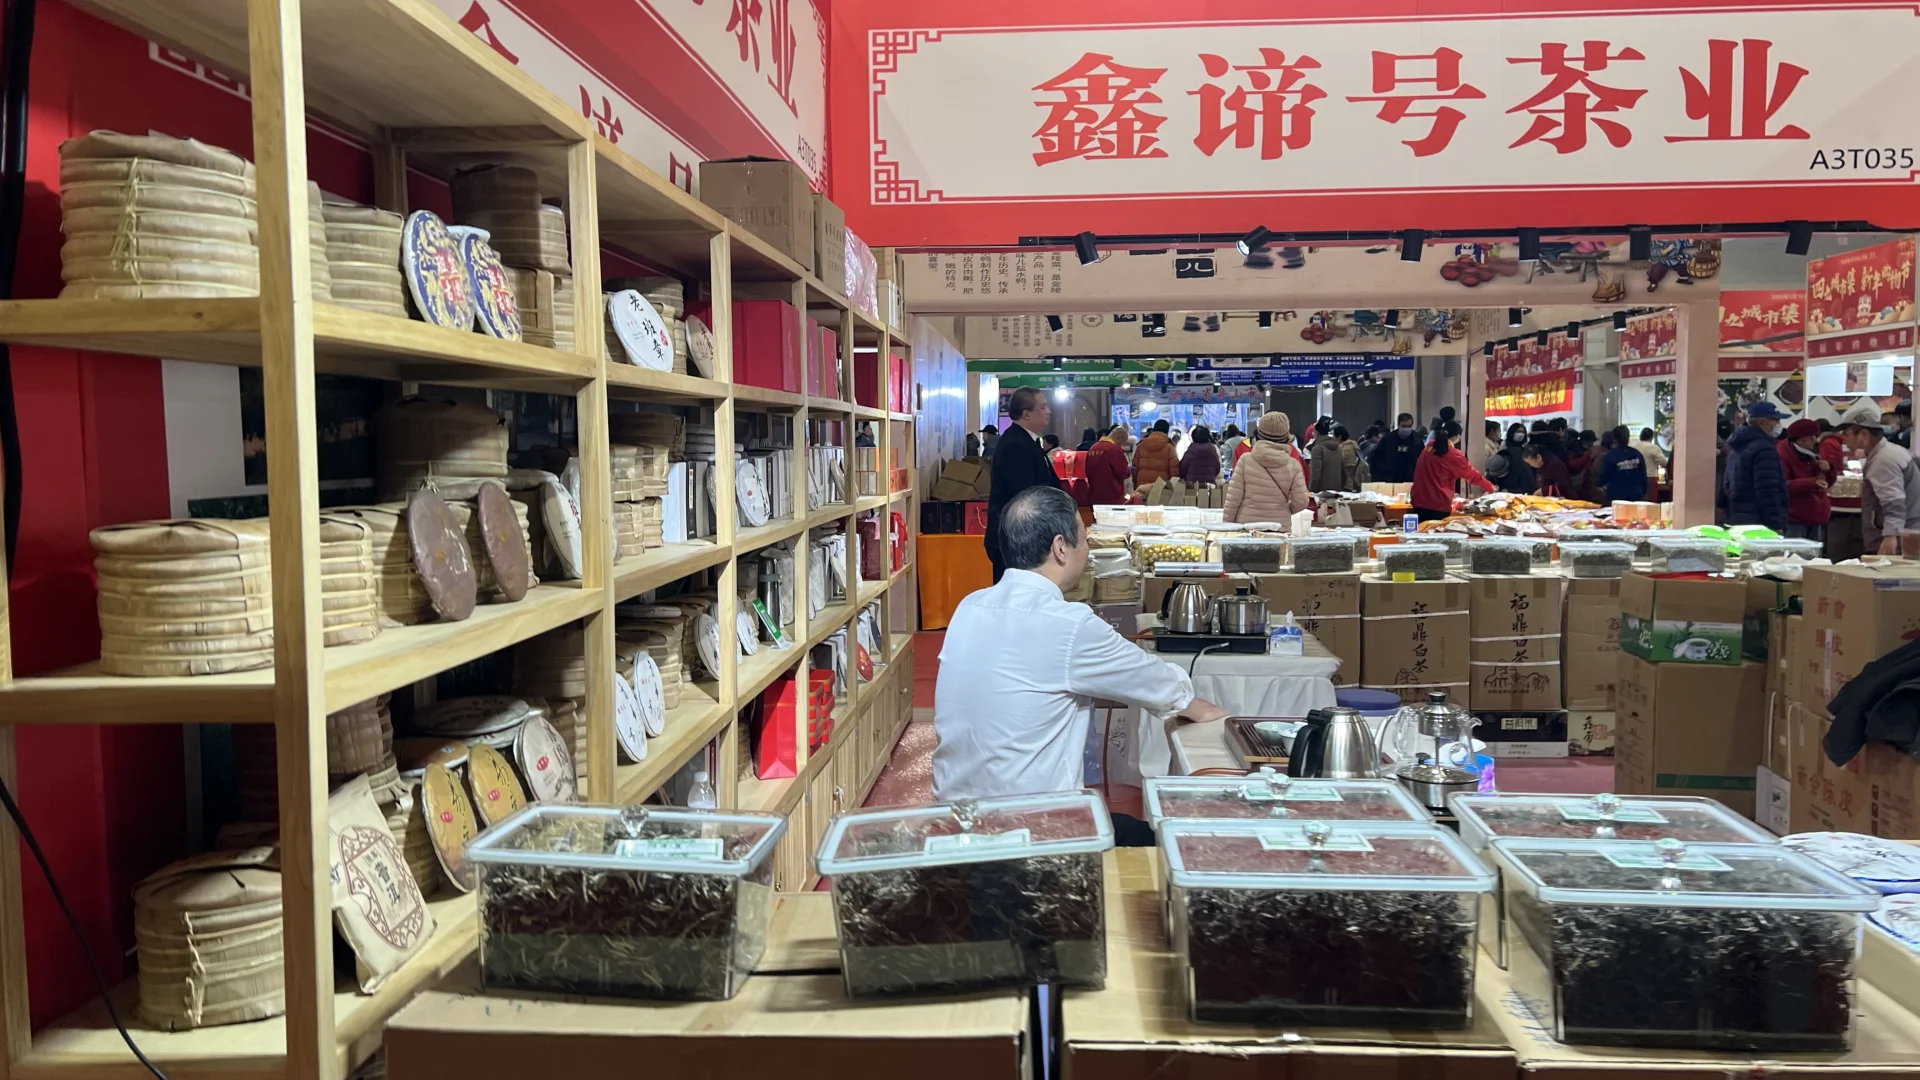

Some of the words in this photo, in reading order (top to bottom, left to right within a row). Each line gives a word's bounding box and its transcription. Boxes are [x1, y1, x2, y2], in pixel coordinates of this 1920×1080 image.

[1031, 38, 1811, 168] 鑫谛号茶业
[797, 134, 817, 175] A3T035
[1809, 147, 1914, 171] A3T035
[628, 292, 666, 364] 老班章
[1720, 303, 1801, 328] 九城市集
